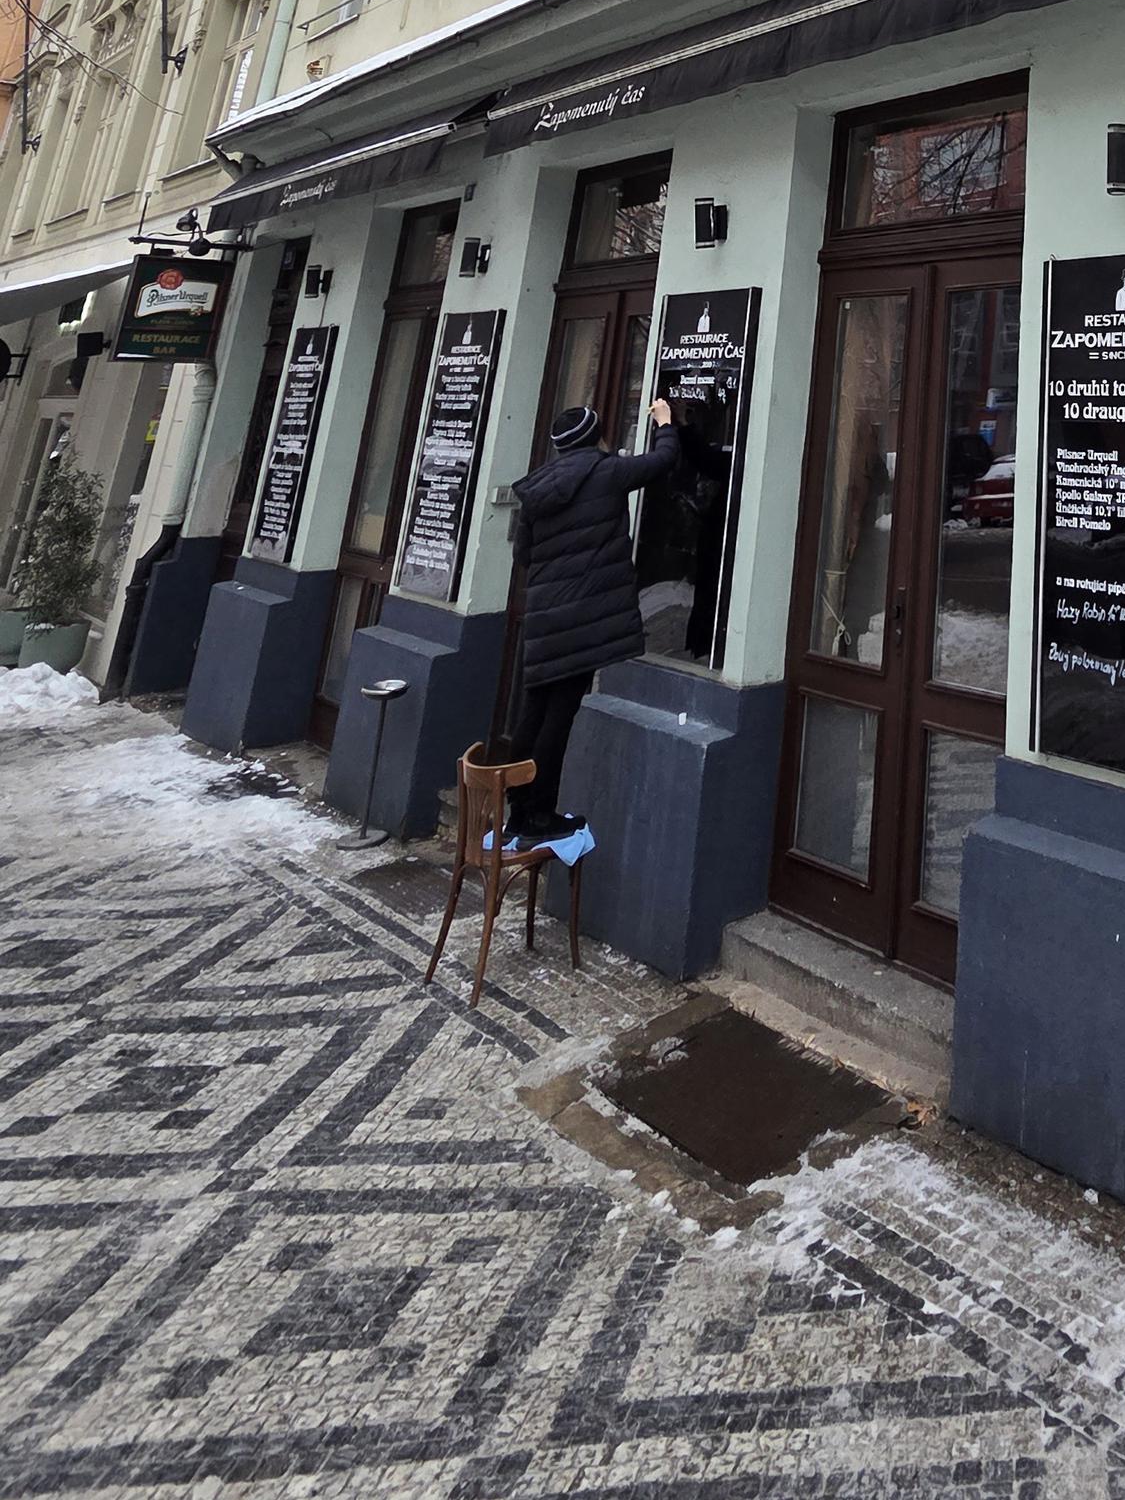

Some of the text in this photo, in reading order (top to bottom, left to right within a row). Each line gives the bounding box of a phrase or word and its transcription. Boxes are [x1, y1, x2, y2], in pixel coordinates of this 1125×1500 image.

[534, 84, 646, 131] Zapomenutý čas
[146, 289, 208, 307] Pilsner Urquell
[132, 333, 200, 344] RESTAURACE
[680, 333, 729, 345] RESTAURACE
[152, 346, 177, 354] BAR
[661, 344, 724, 359] ZAPOMENUTÝ
[1049, 380, 1064, 396] 10
[1067, 379, 1109, 396] druhů
[1063, 403, 1079, 419] 10
[1057, 448, 1118, 463] Pilsner Urquell
[1056, 461, 1109, 477] Vinohradský
[1056, 475, 1102, 488] Kamenická
[1056, 488, 1081, 501] Apollo
[1083, 490, 1112, 505] Galaxy
[1079, 517, 1111, 530] Pomelo
[1056, 598, 1080, 624] Hazy
